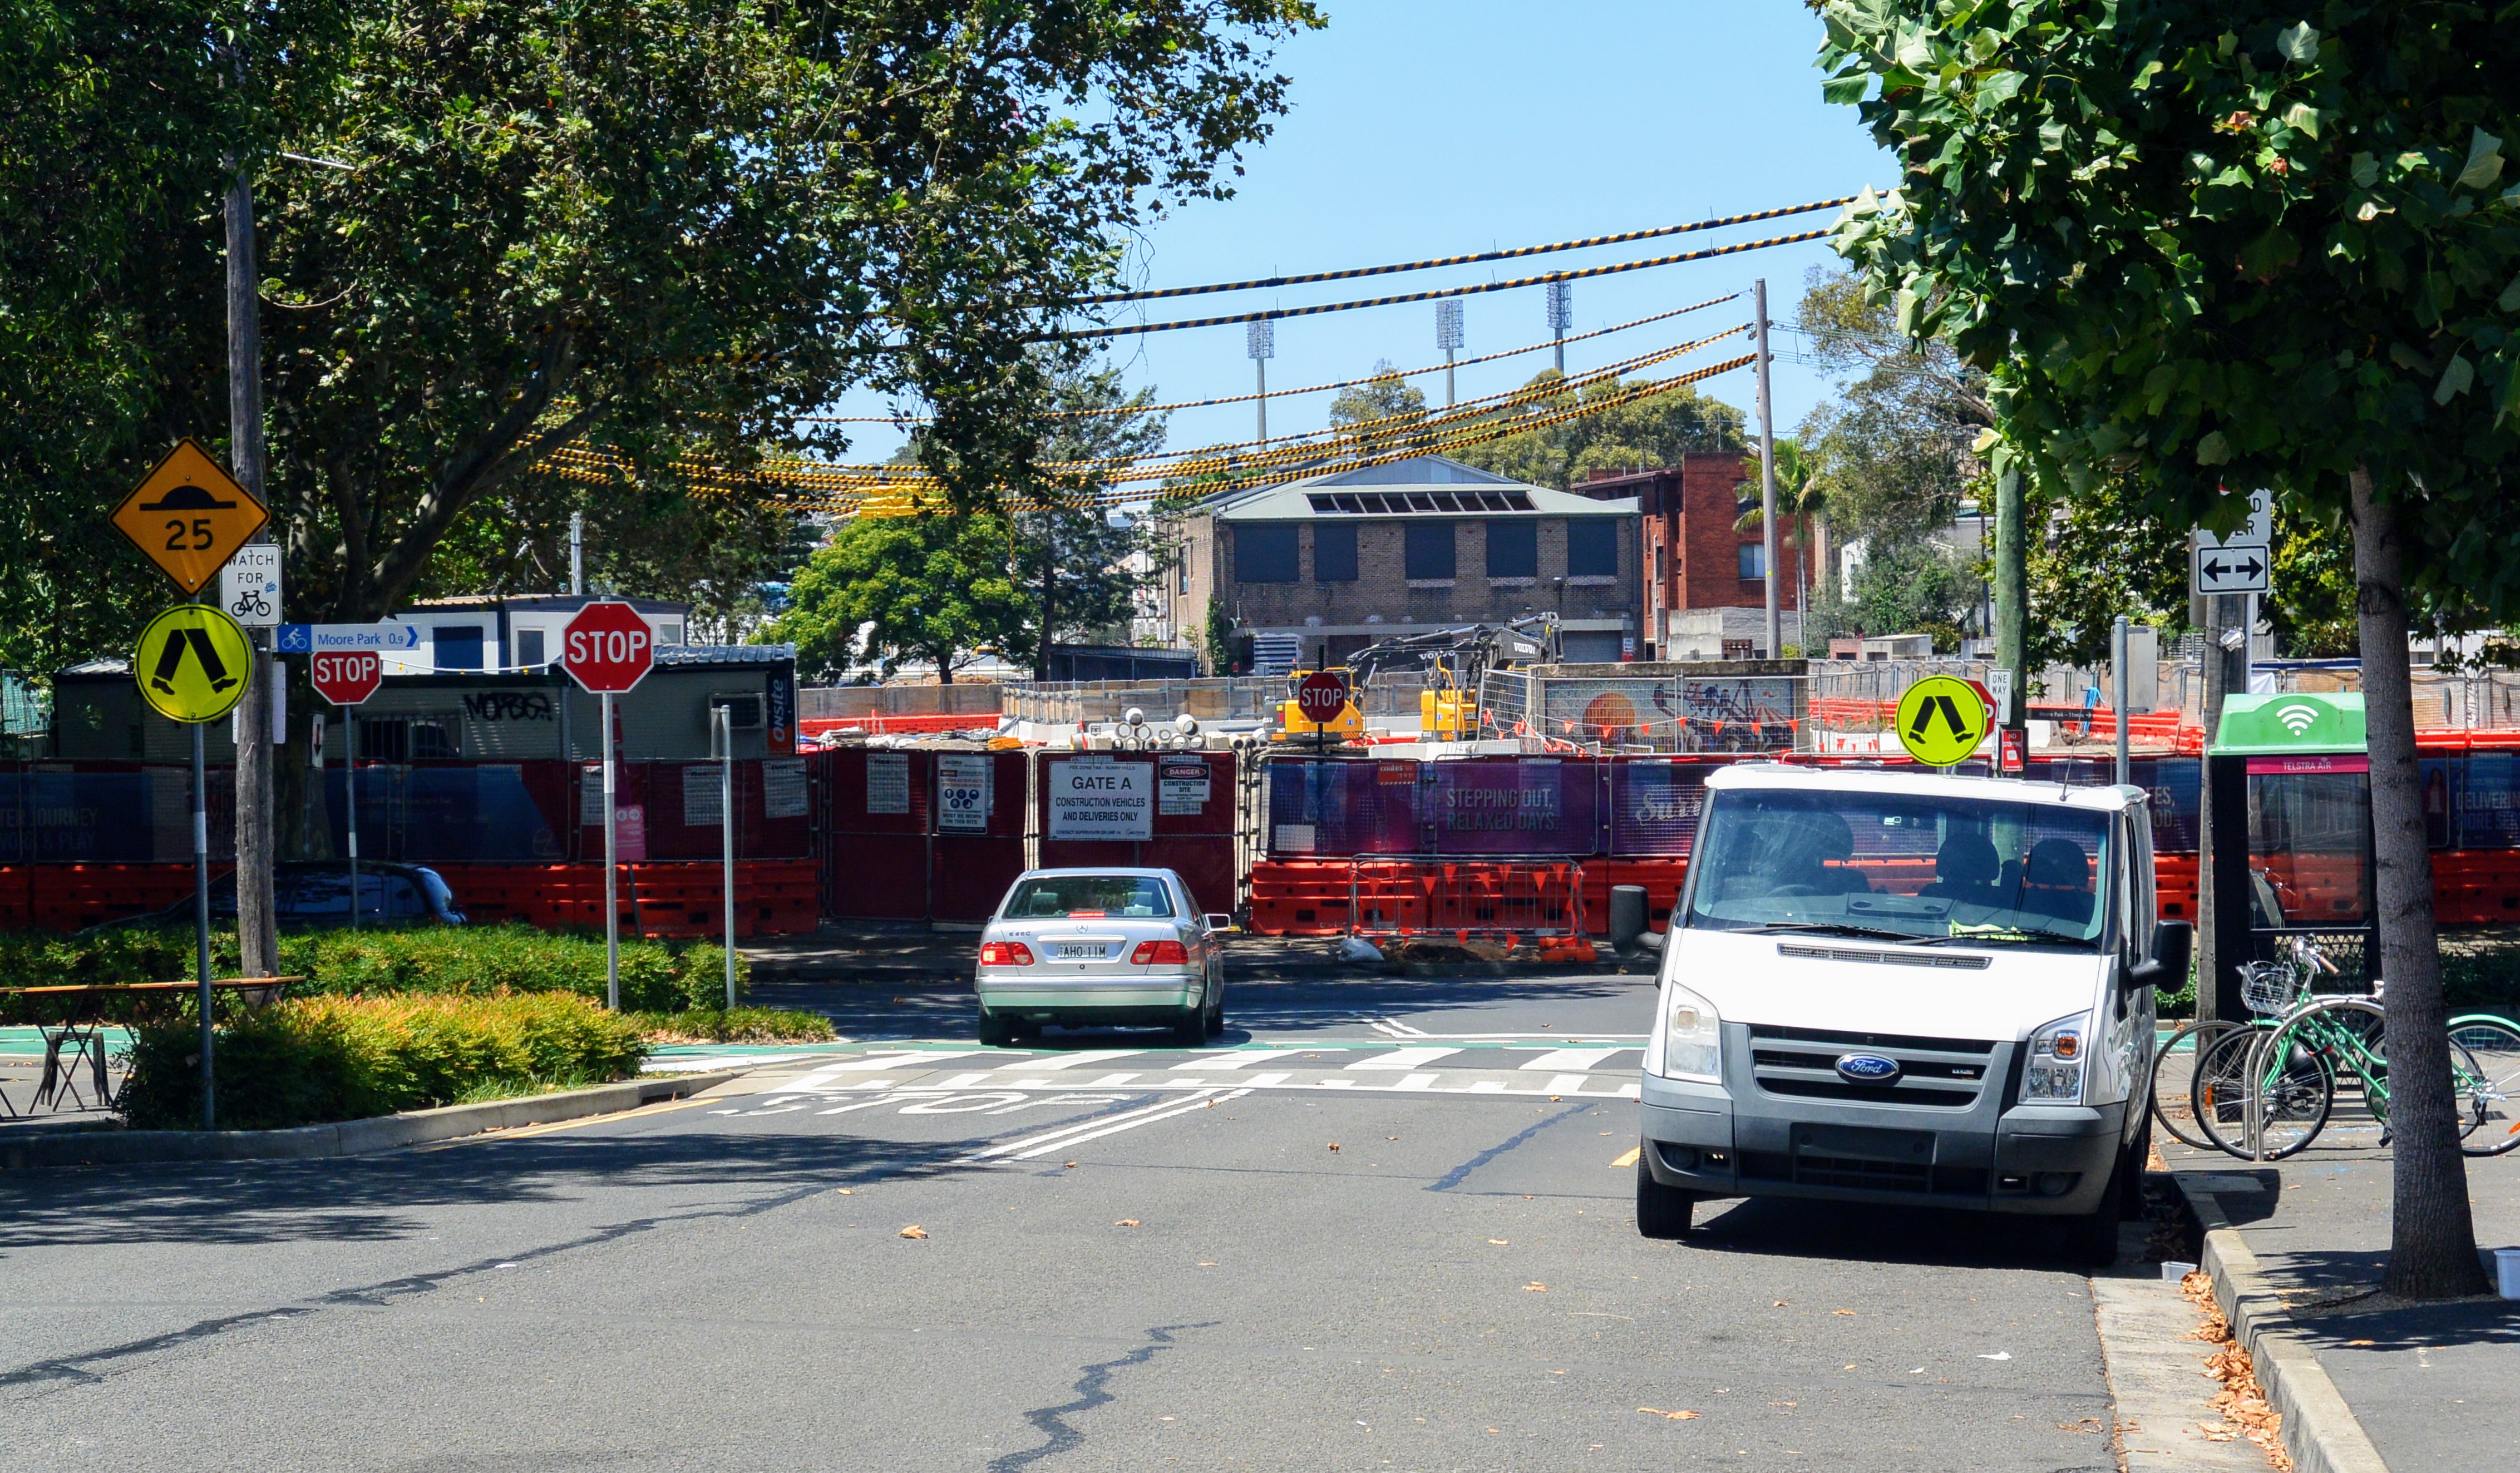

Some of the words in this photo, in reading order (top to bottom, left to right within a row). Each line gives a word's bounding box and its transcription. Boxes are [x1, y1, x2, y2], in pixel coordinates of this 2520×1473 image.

[165, 519, 213, 551] 25
[228, 554, 273, 566] WATCH
[238, 572, 263, 584] FOR
[318, 634, 354, 645] Moore
[357, 633, 381, 645] Park
[388, 633, 403, 645] 0.9
[569, 630, 647, 664] STOP
[1513, 642, 1532, 654] VOLVO
[317, 656, 376, 683] STOP
[1993, 674, 2008, 684] ONE
[1992, 685, 2008, 695] WAY
[1301, 688, 1343, 707] STOP
[2283, 762, 2316, 770] TELSTRA
[1072, 776, 1116, 790] GATE
[1120, 777, 1132, 790] A
[1056, 797, 1111, 807] CONSTRUCTION
[1111, 798, 1146, 807] VEHICLES
[1447, 788, 1518, 808] STEPPING
[1522, 788, 1553, 810] OUT,
[1062, 812, 1077, 821] AND
[1079, 812, 1118, 821] DELIVERIES
[1120, 812, 1138, 821] ONLY
[1447, 812, 1515, 831] RELAXED
[1518, 812, 1559, 831] DAYS.
[1851, 1059, 1883, 1074] Ford
